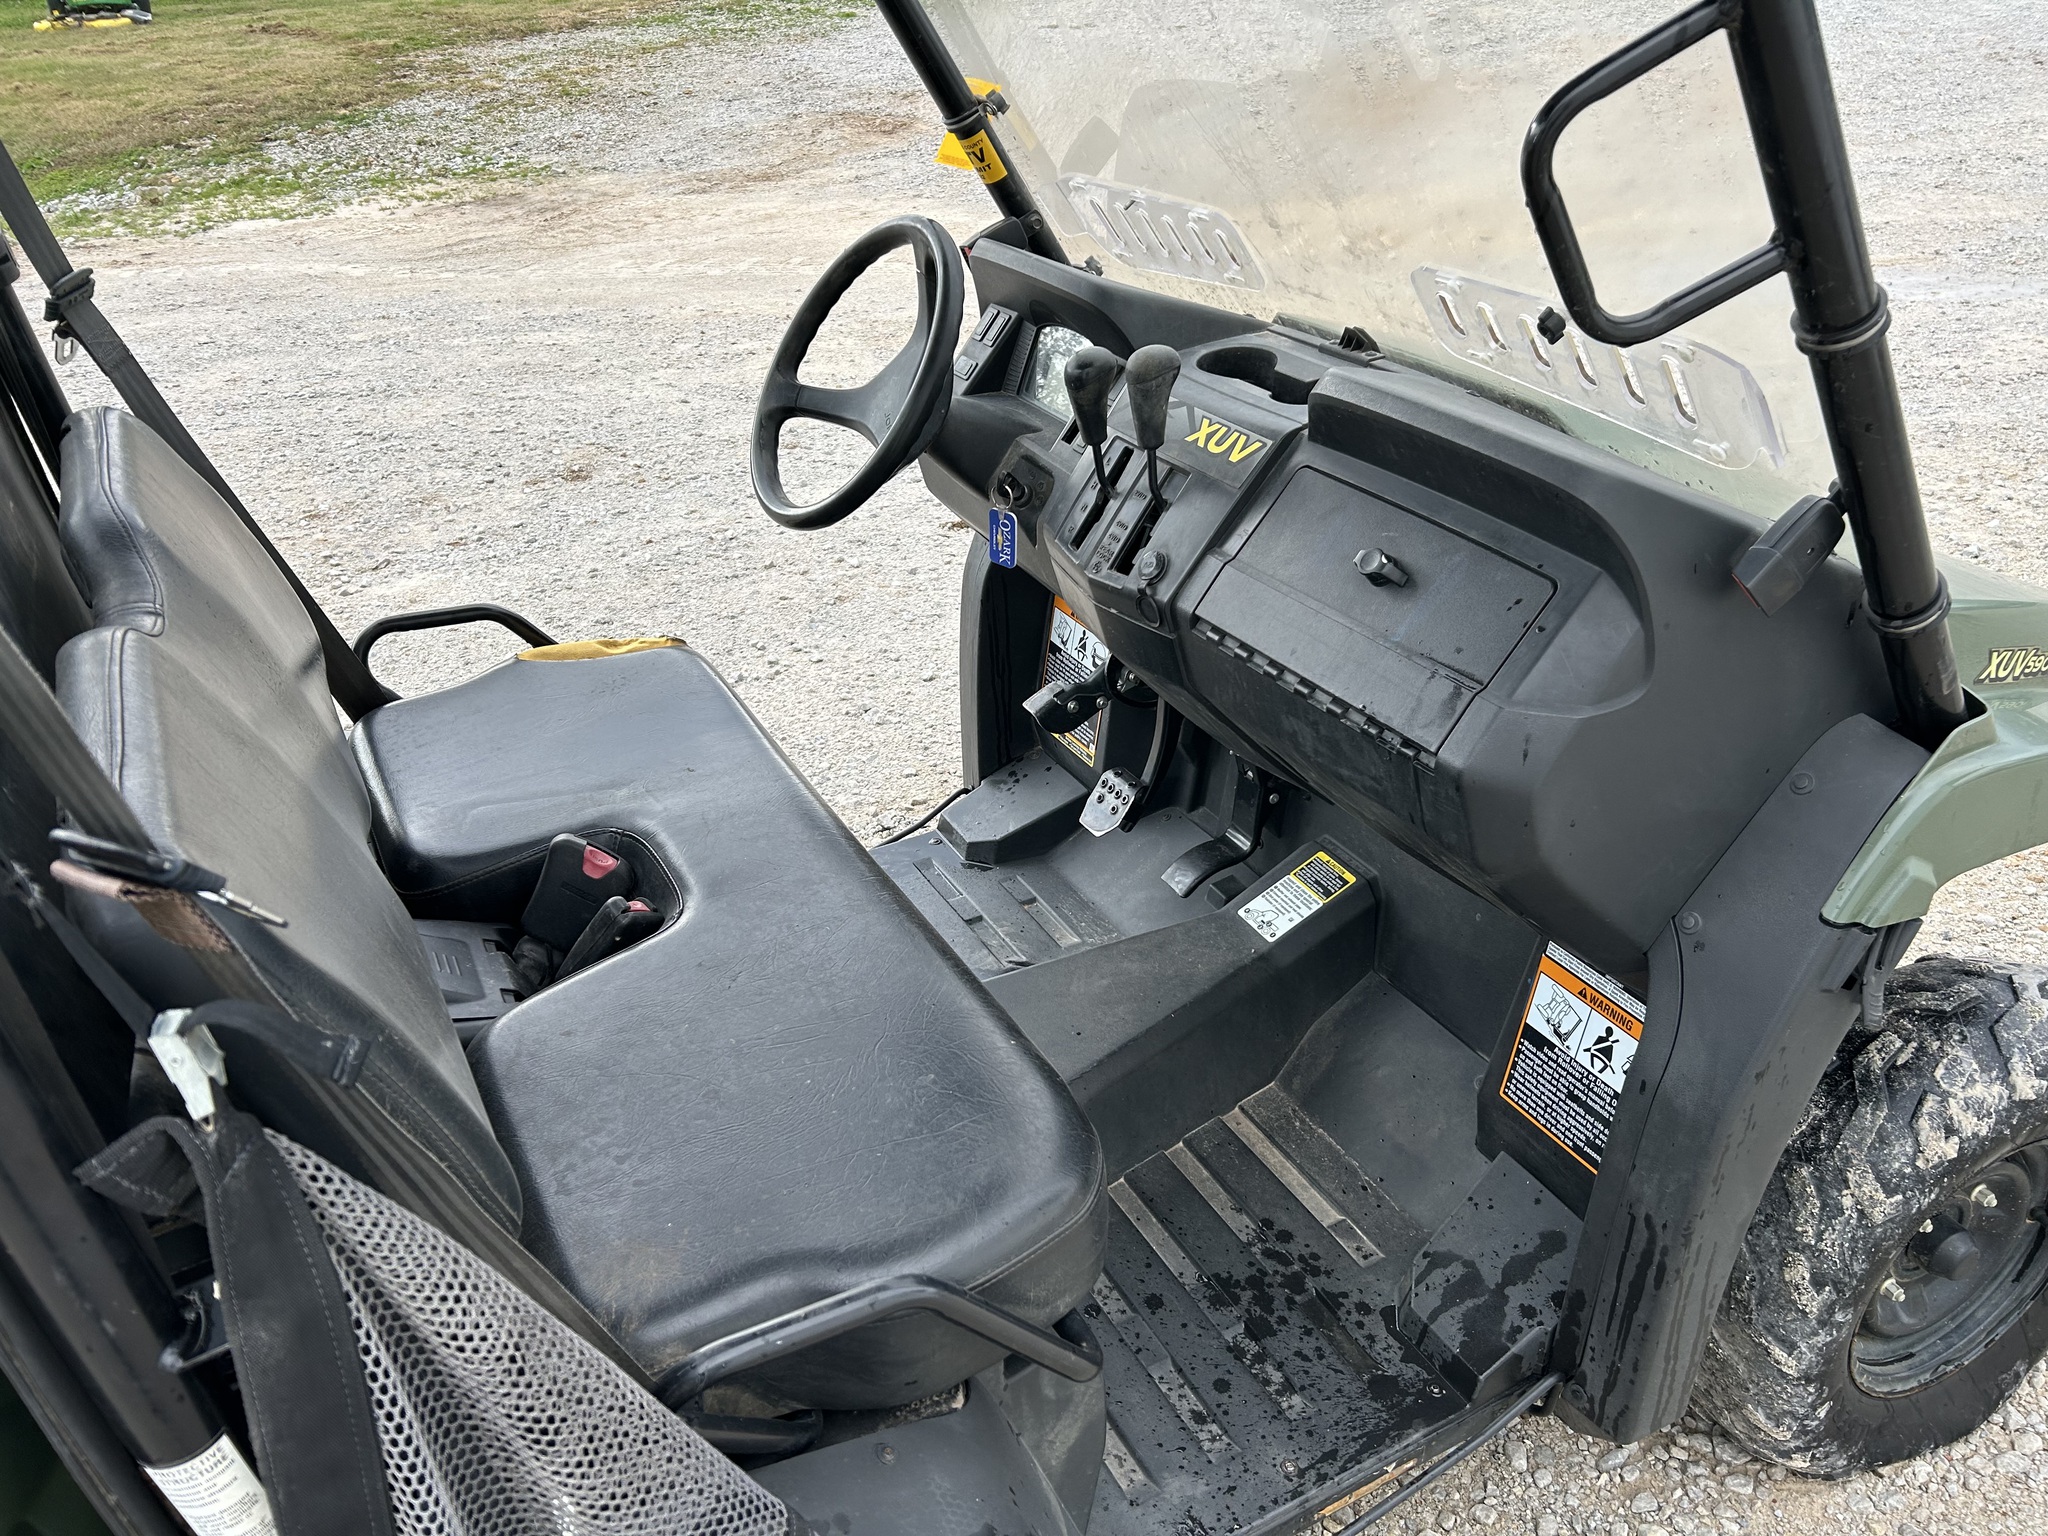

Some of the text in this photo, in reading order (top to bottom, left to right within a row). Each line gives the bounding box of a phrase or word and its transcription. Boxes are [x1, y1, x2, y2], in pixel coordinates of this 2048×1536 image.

[966, 147, 986, 163] TV
[976, 163, 992, 173] MIT
[1183, 417, 1264, 464] XUV
[999, 520, 1011, 565] OZARK
[1588, 992, 1633, 1032] WARNING
[1543, 1045, 1557, 1061] from
[1557, 1056, 1582, 1080] Rollover
[1582, 1077, 1589, 1086] or
[1589, 1081, 1611, 1103] Falling
[1553, 1045, 1614, 1097] Avoid Injury or Death
